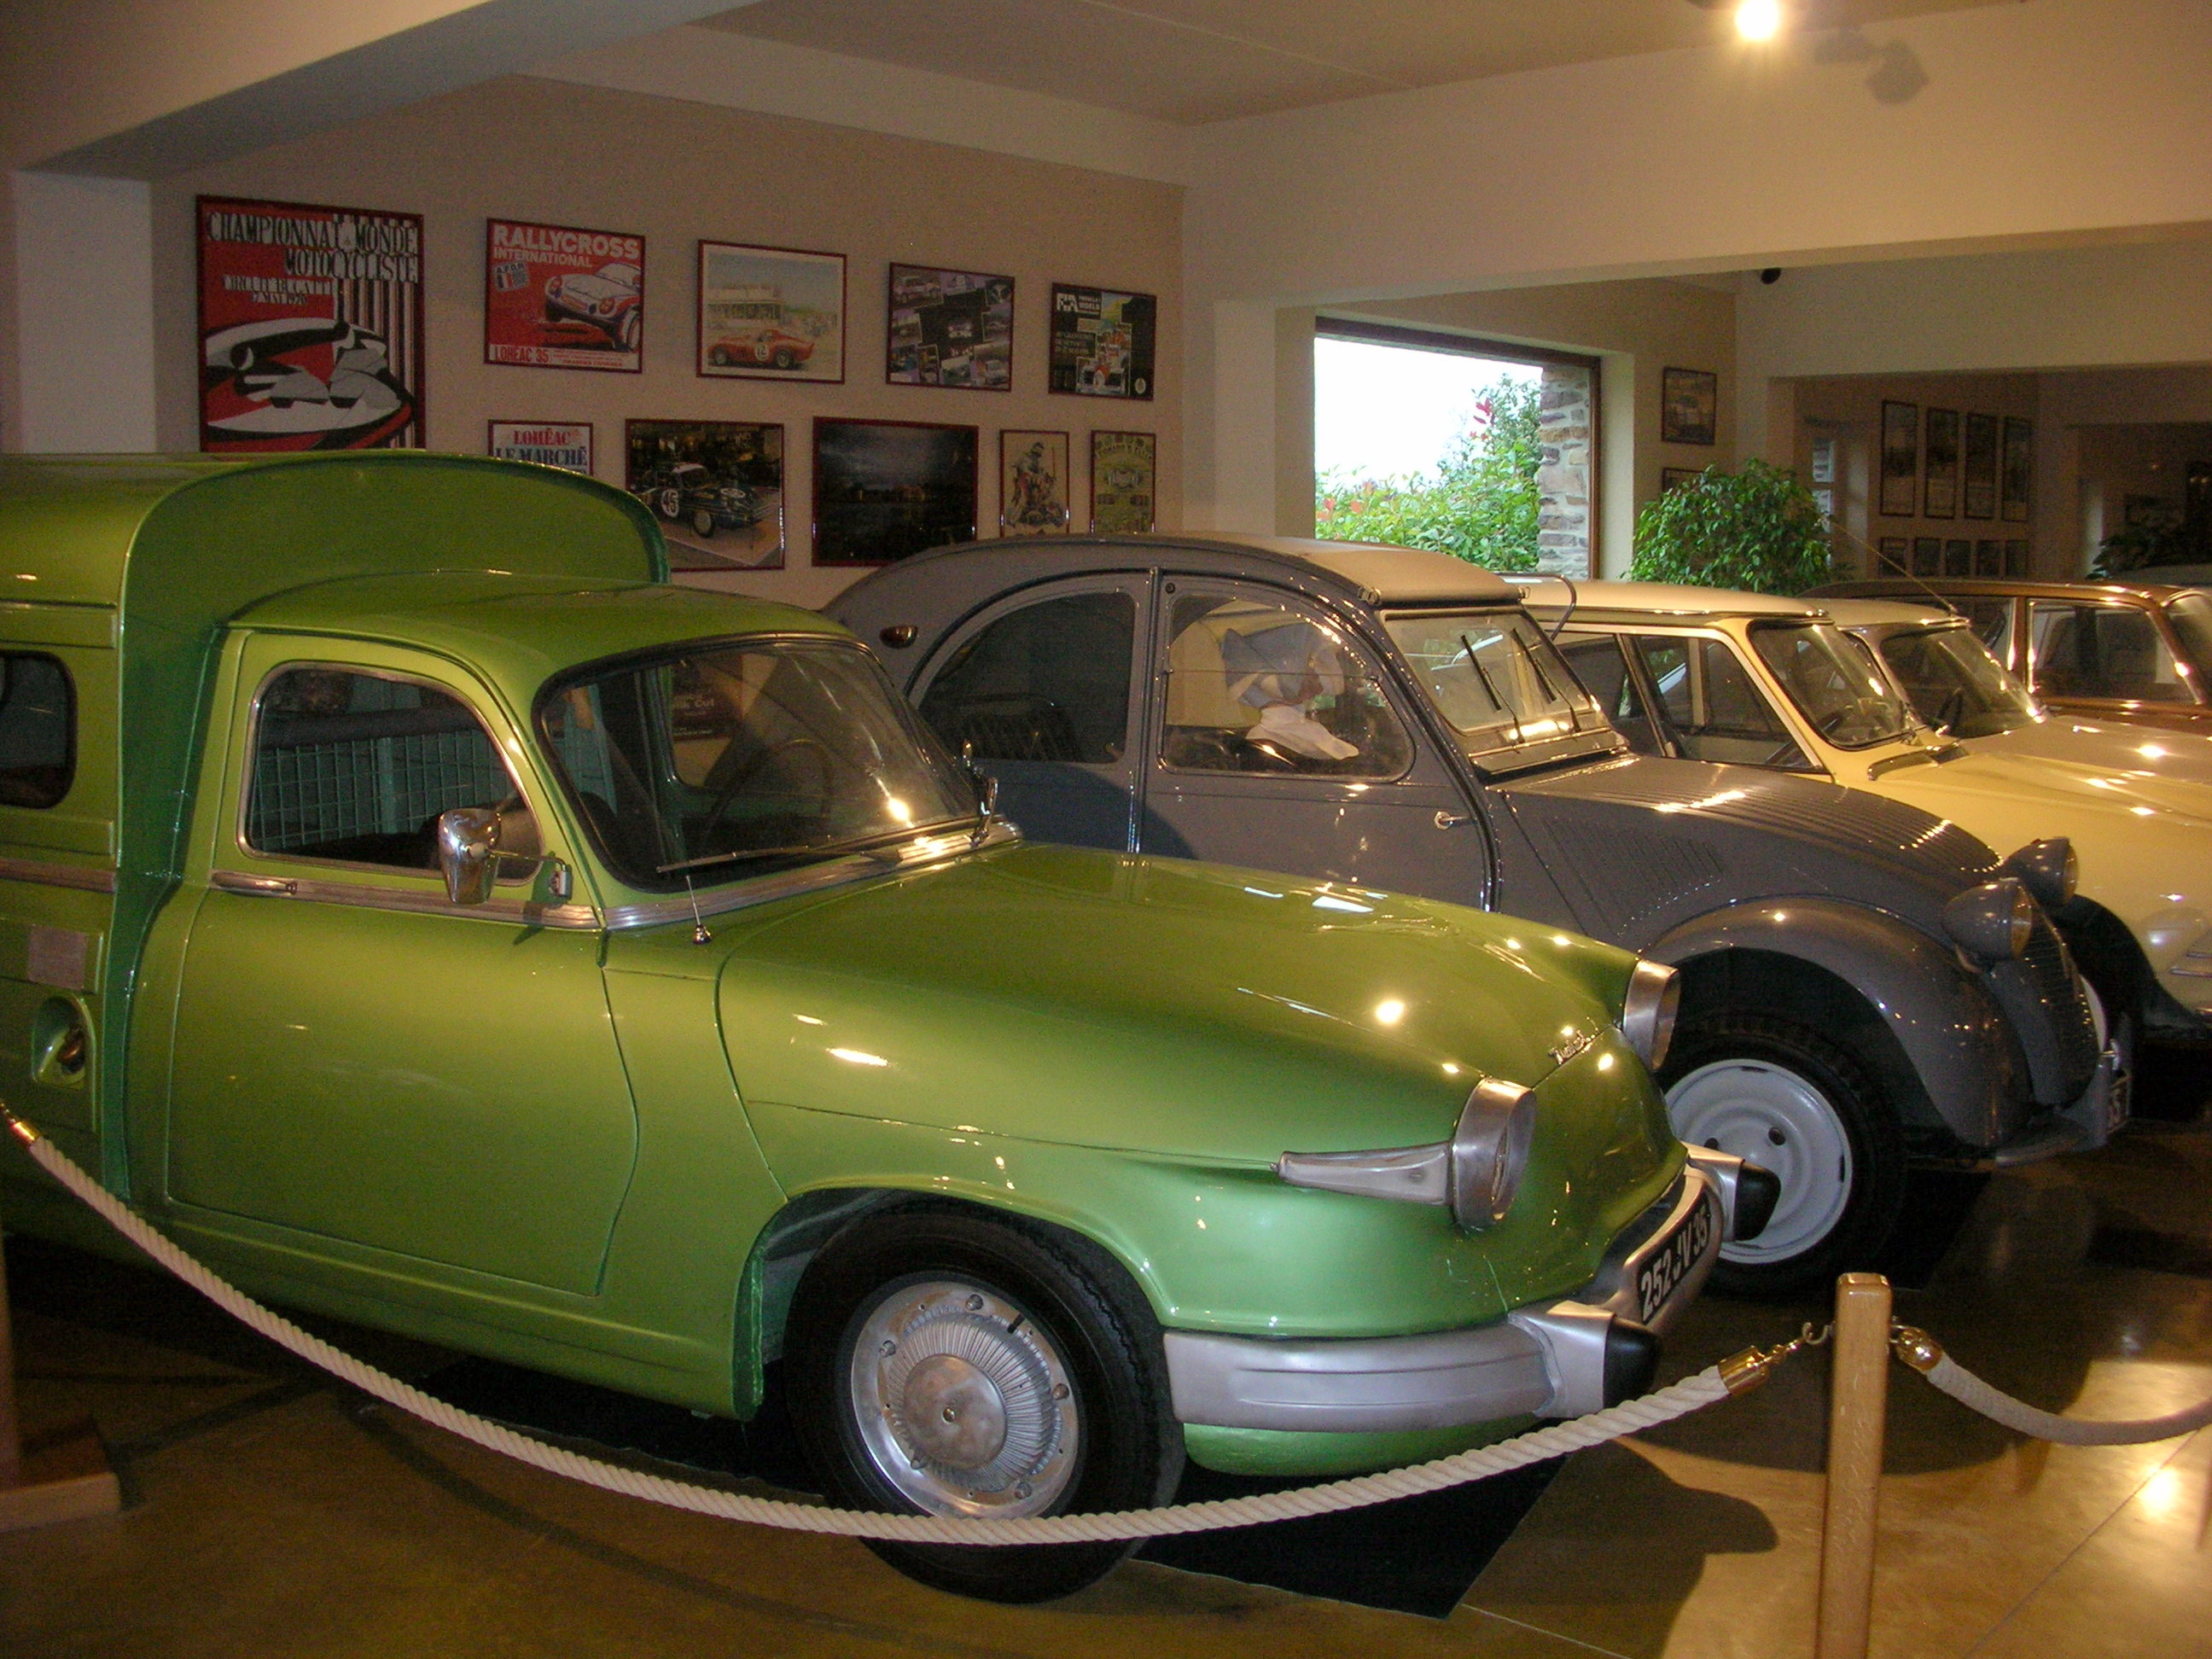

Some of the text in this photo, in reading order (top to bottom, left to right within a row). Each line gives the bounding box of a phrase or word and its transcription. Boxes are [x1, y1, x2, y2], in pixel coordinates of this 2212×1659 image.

[207, 212, 419, 256] CHAMPIONNAT MONDE
[493, 224, 640, 261] RALLYCROSS
[284, 247, 419, 284] MOTOCYCLISTE
[494, 246, 592, 267] INTERNATIONAL
[519, 446, 587, 466] MARCHÉ
[1641, 1204, 1708, 1322] 252 JV 35
